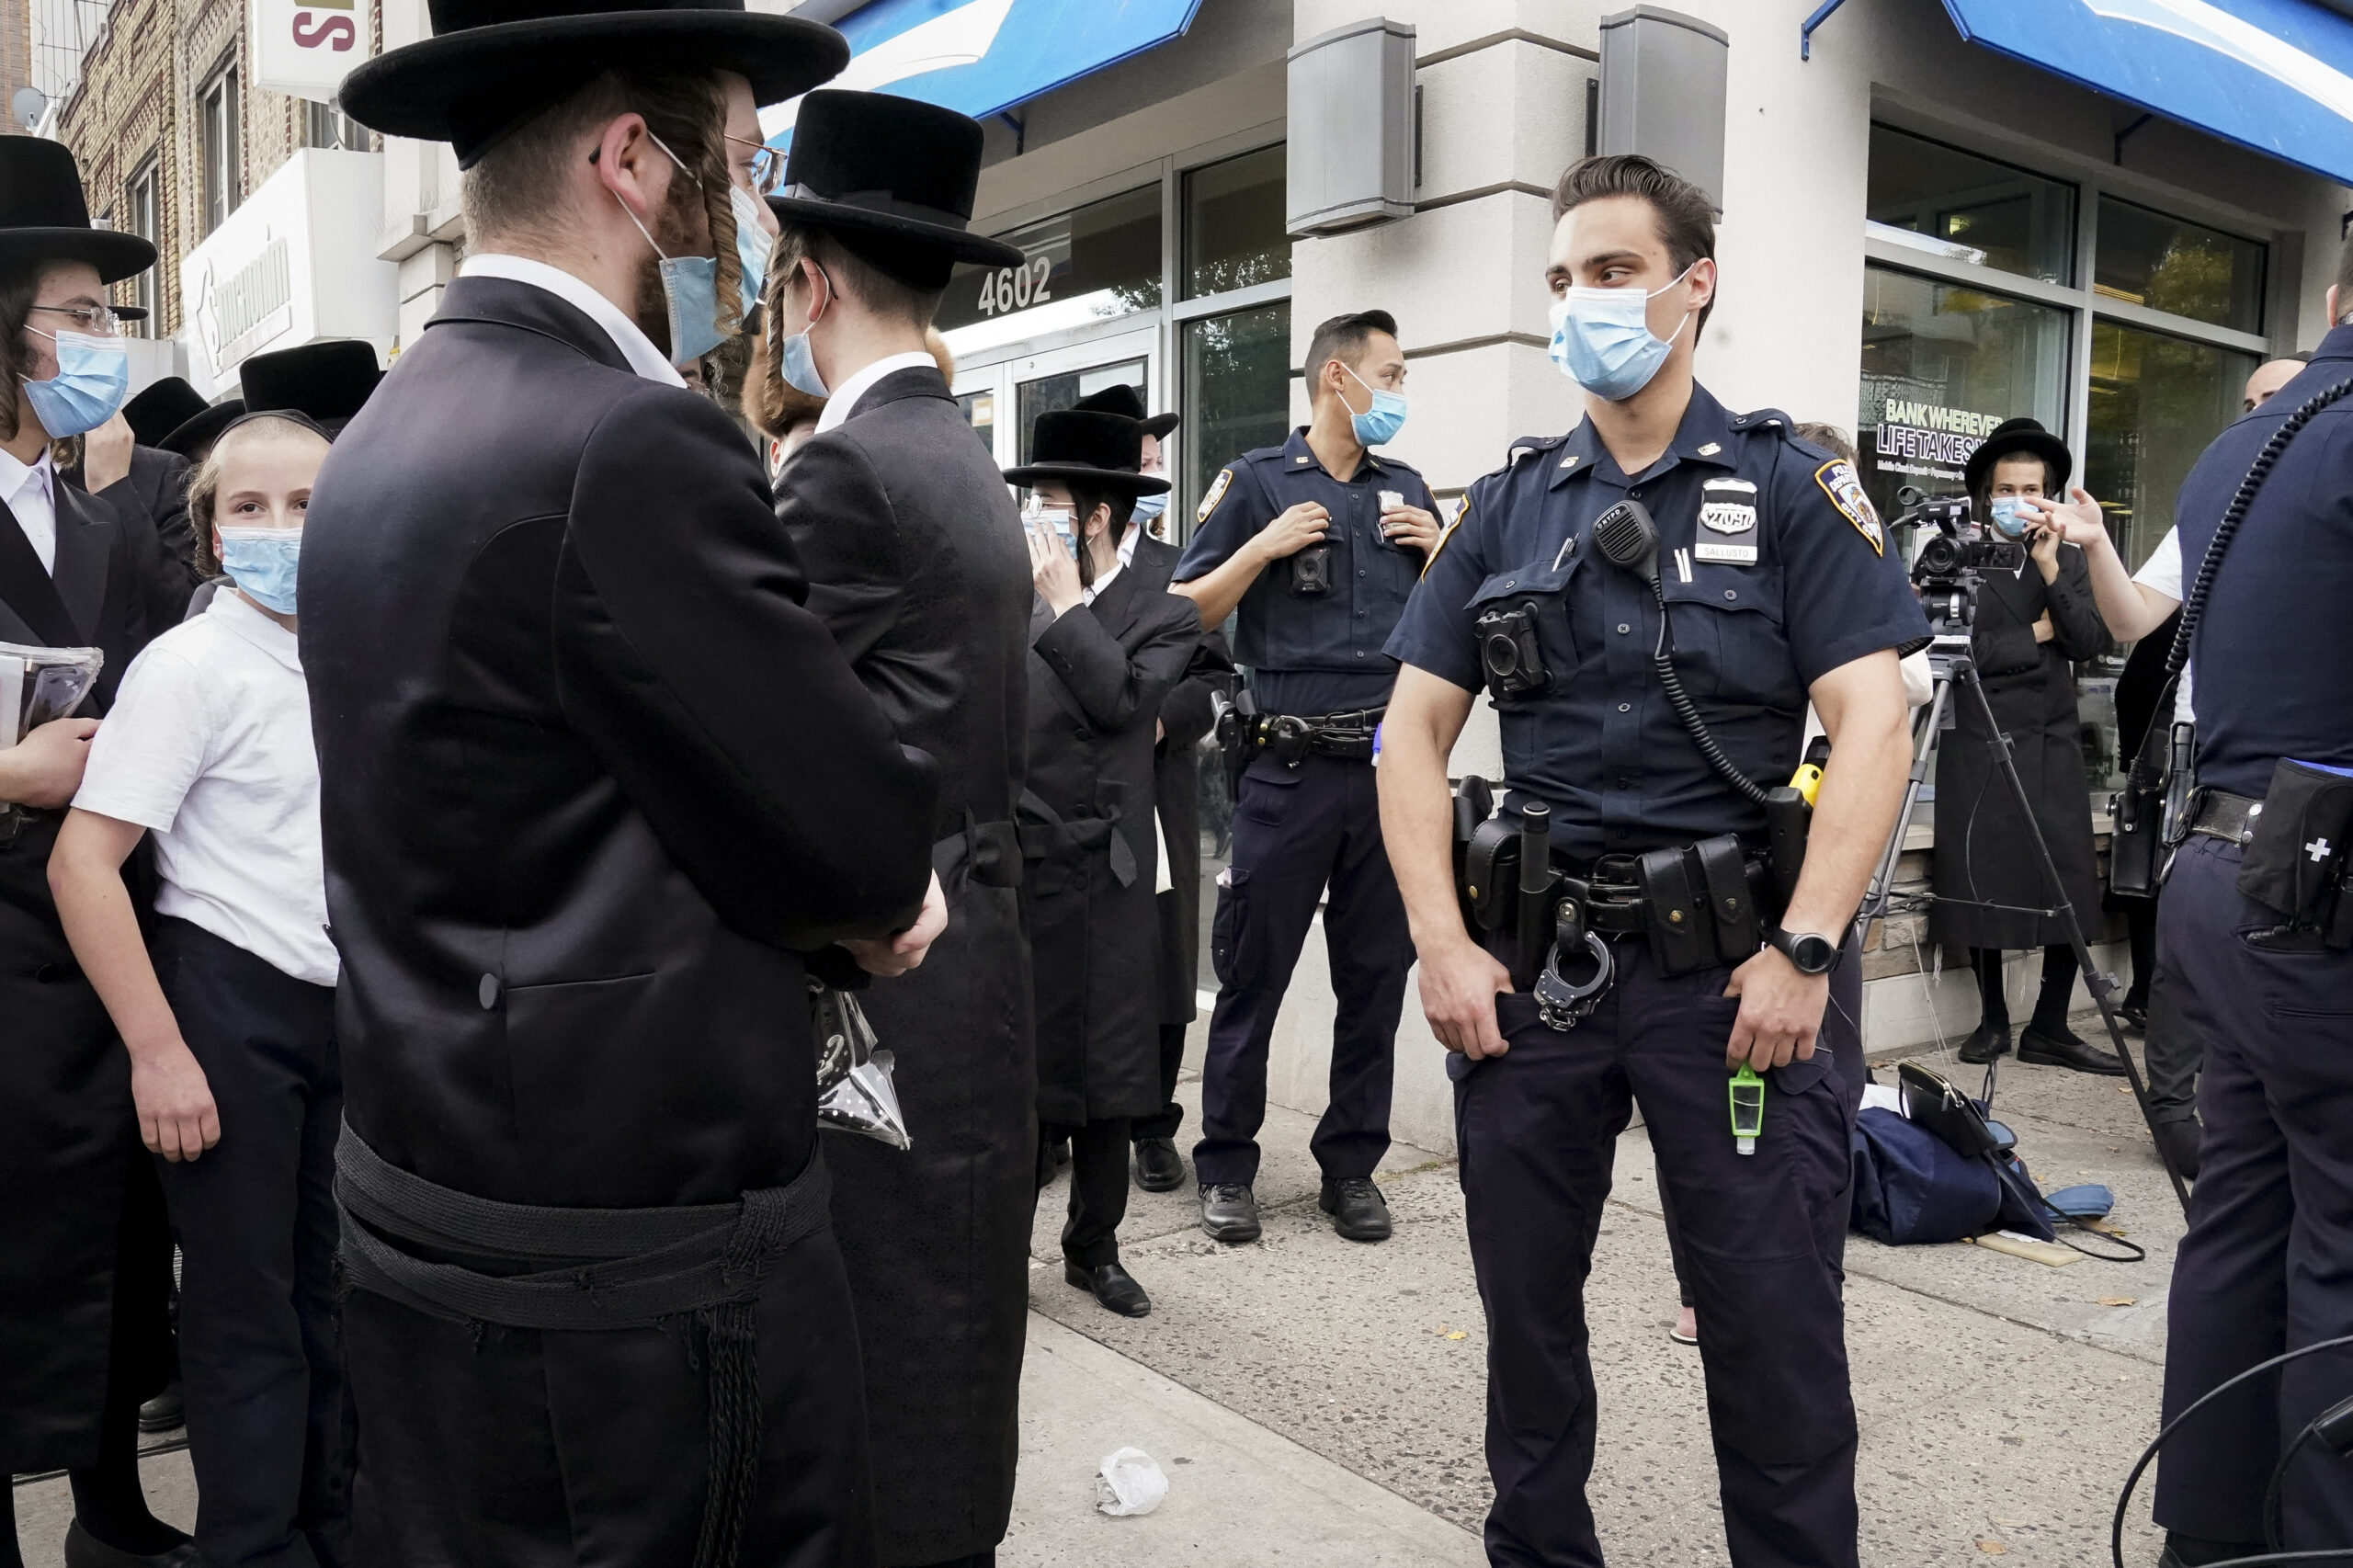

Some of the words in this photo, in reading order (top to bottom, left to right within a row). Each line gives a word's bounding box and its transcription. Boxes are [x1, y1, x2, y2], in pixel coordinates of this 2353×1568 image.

[978, 256, 1051, 316] 4602
[1886, 398, 1927, 427] BANK
[1876, 423, 1916, 458] LIFE
[1916, 429, 1974, 466] TAKES
[1602, 509, 1620, 525] NYPD
[1706, 510, 1752, 527] 27097
[1841, 503, 1862, 523] CITY
[1704, 547, 1749, 558] SALLUSTO
